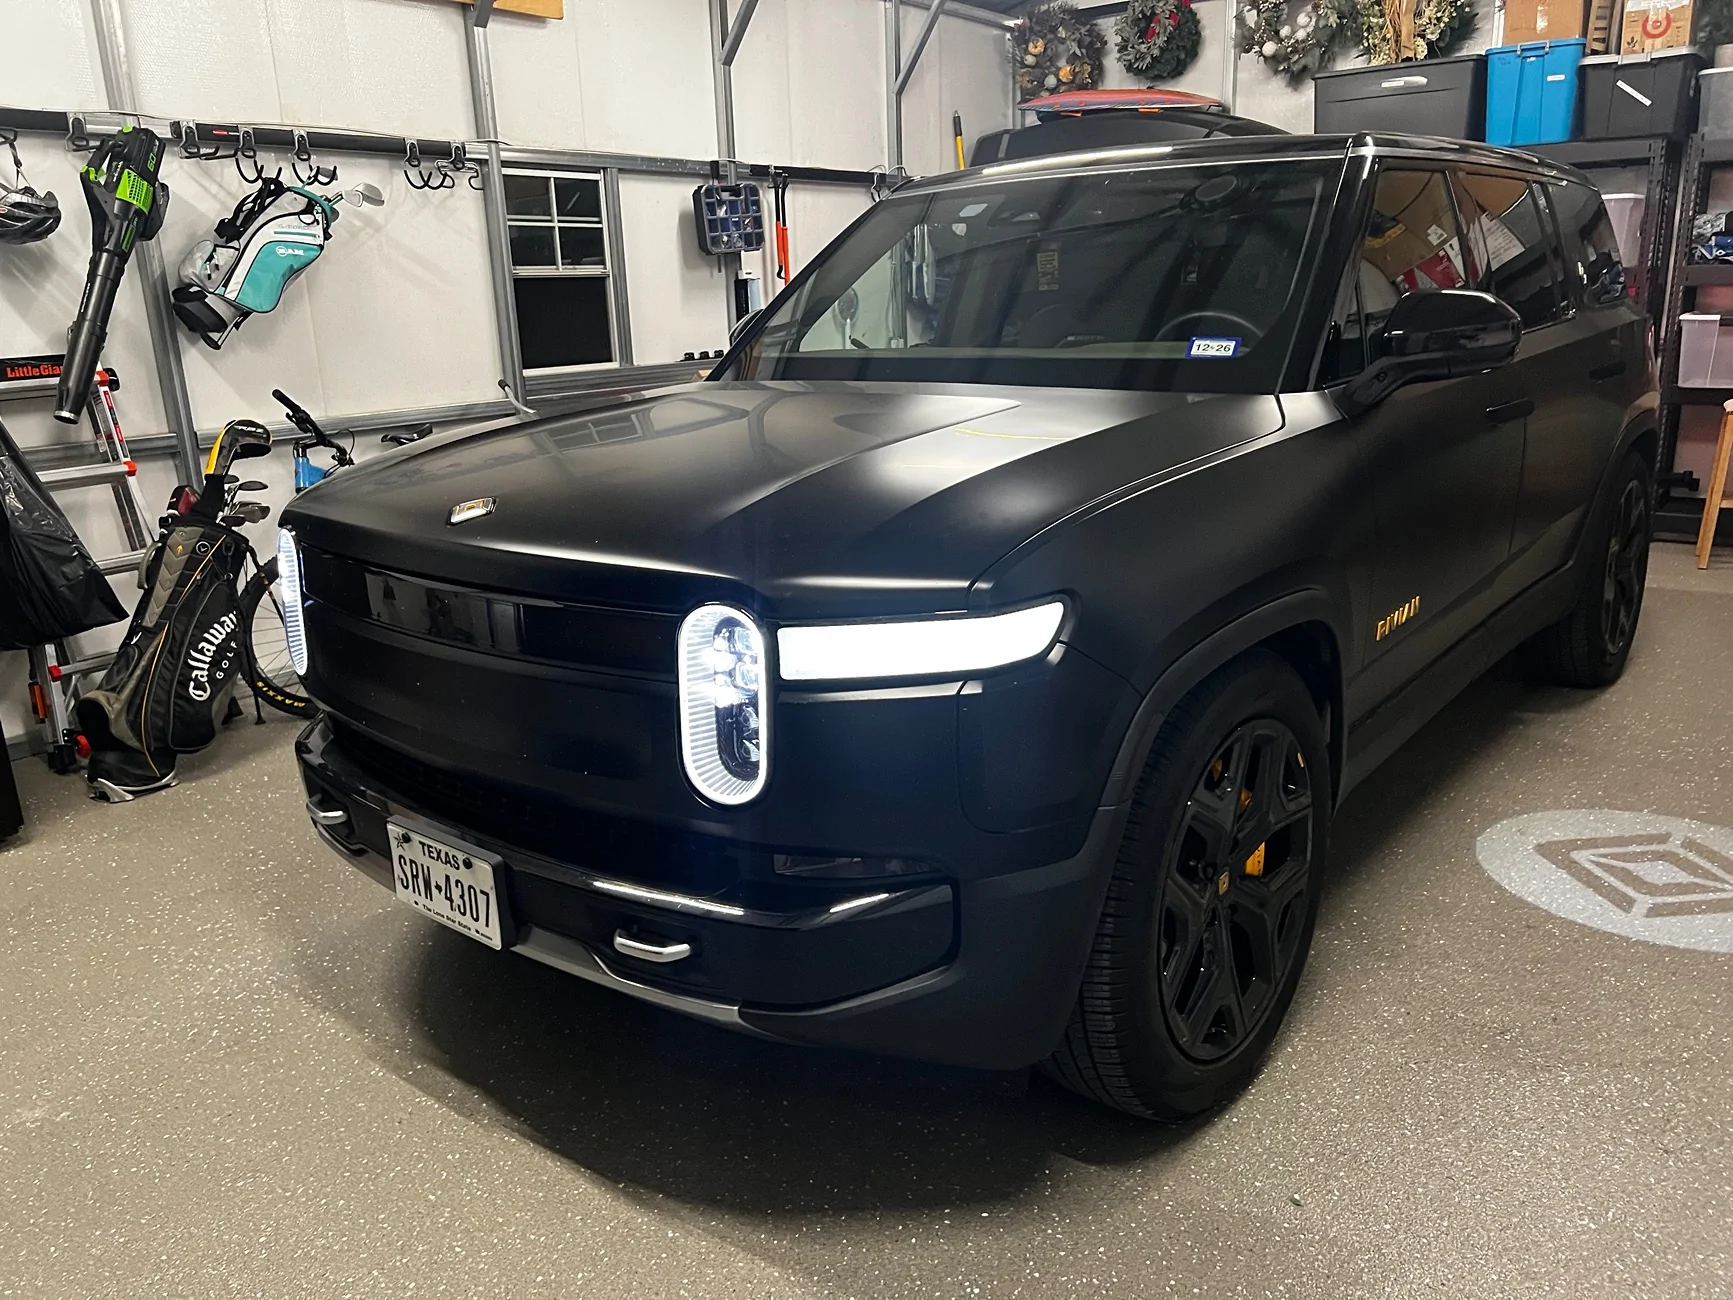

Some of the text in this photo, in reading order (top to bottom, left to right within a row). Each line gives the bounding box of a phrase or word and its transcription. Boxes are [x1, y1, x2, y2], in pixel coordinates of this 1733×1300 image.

[1196, 343, 1231, 352] 12 26
[188, 611, 239, 701] Callaway
[216, 641, 238, 680] GOLF
[418, 841, 460, 870] TEXAS
